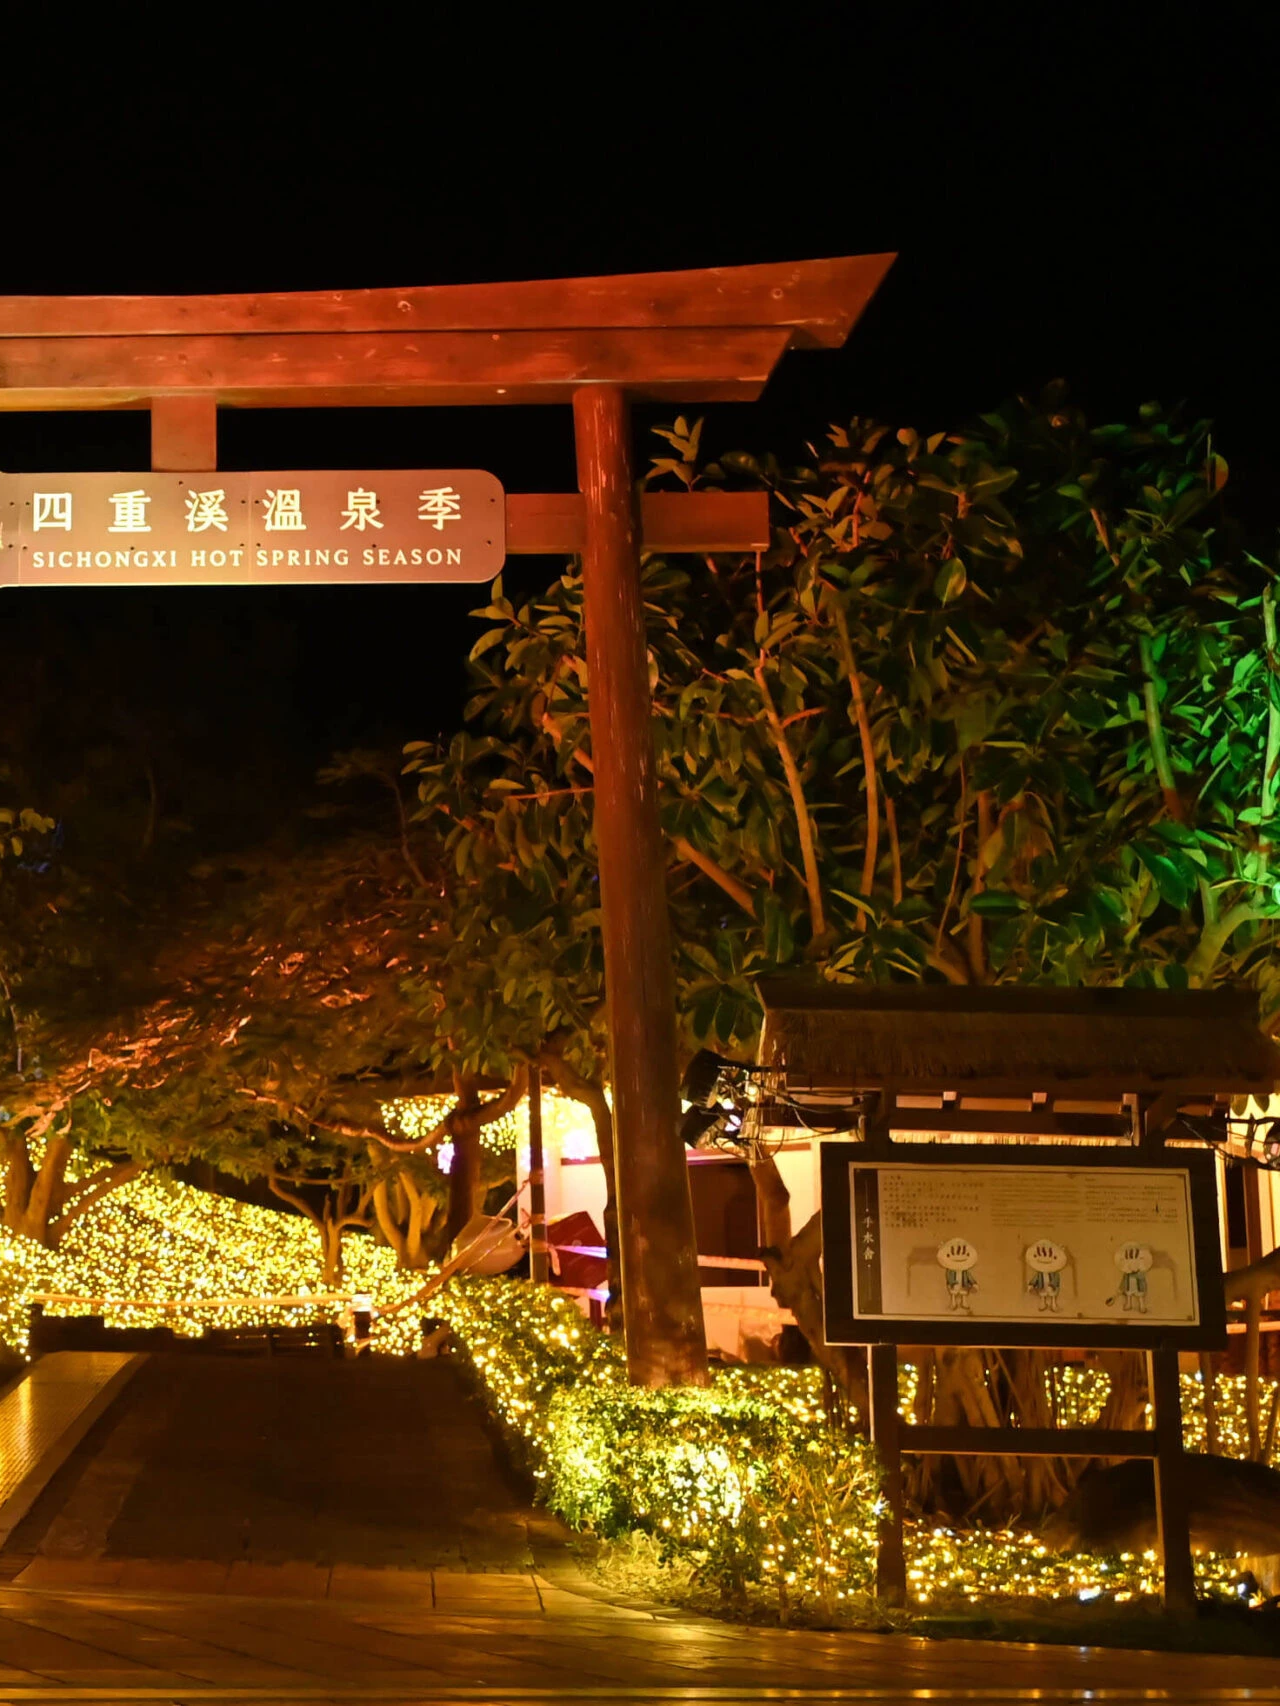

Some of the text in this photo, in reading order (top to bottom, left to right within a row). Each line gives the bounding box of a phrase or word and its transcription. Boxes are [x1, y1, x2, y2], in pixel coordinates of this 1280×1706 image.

[32, 487, 461, 532] 四重溪溫泉季
[32, 548, 461, 567] SICHONGXI HOT SPRING SEASON
